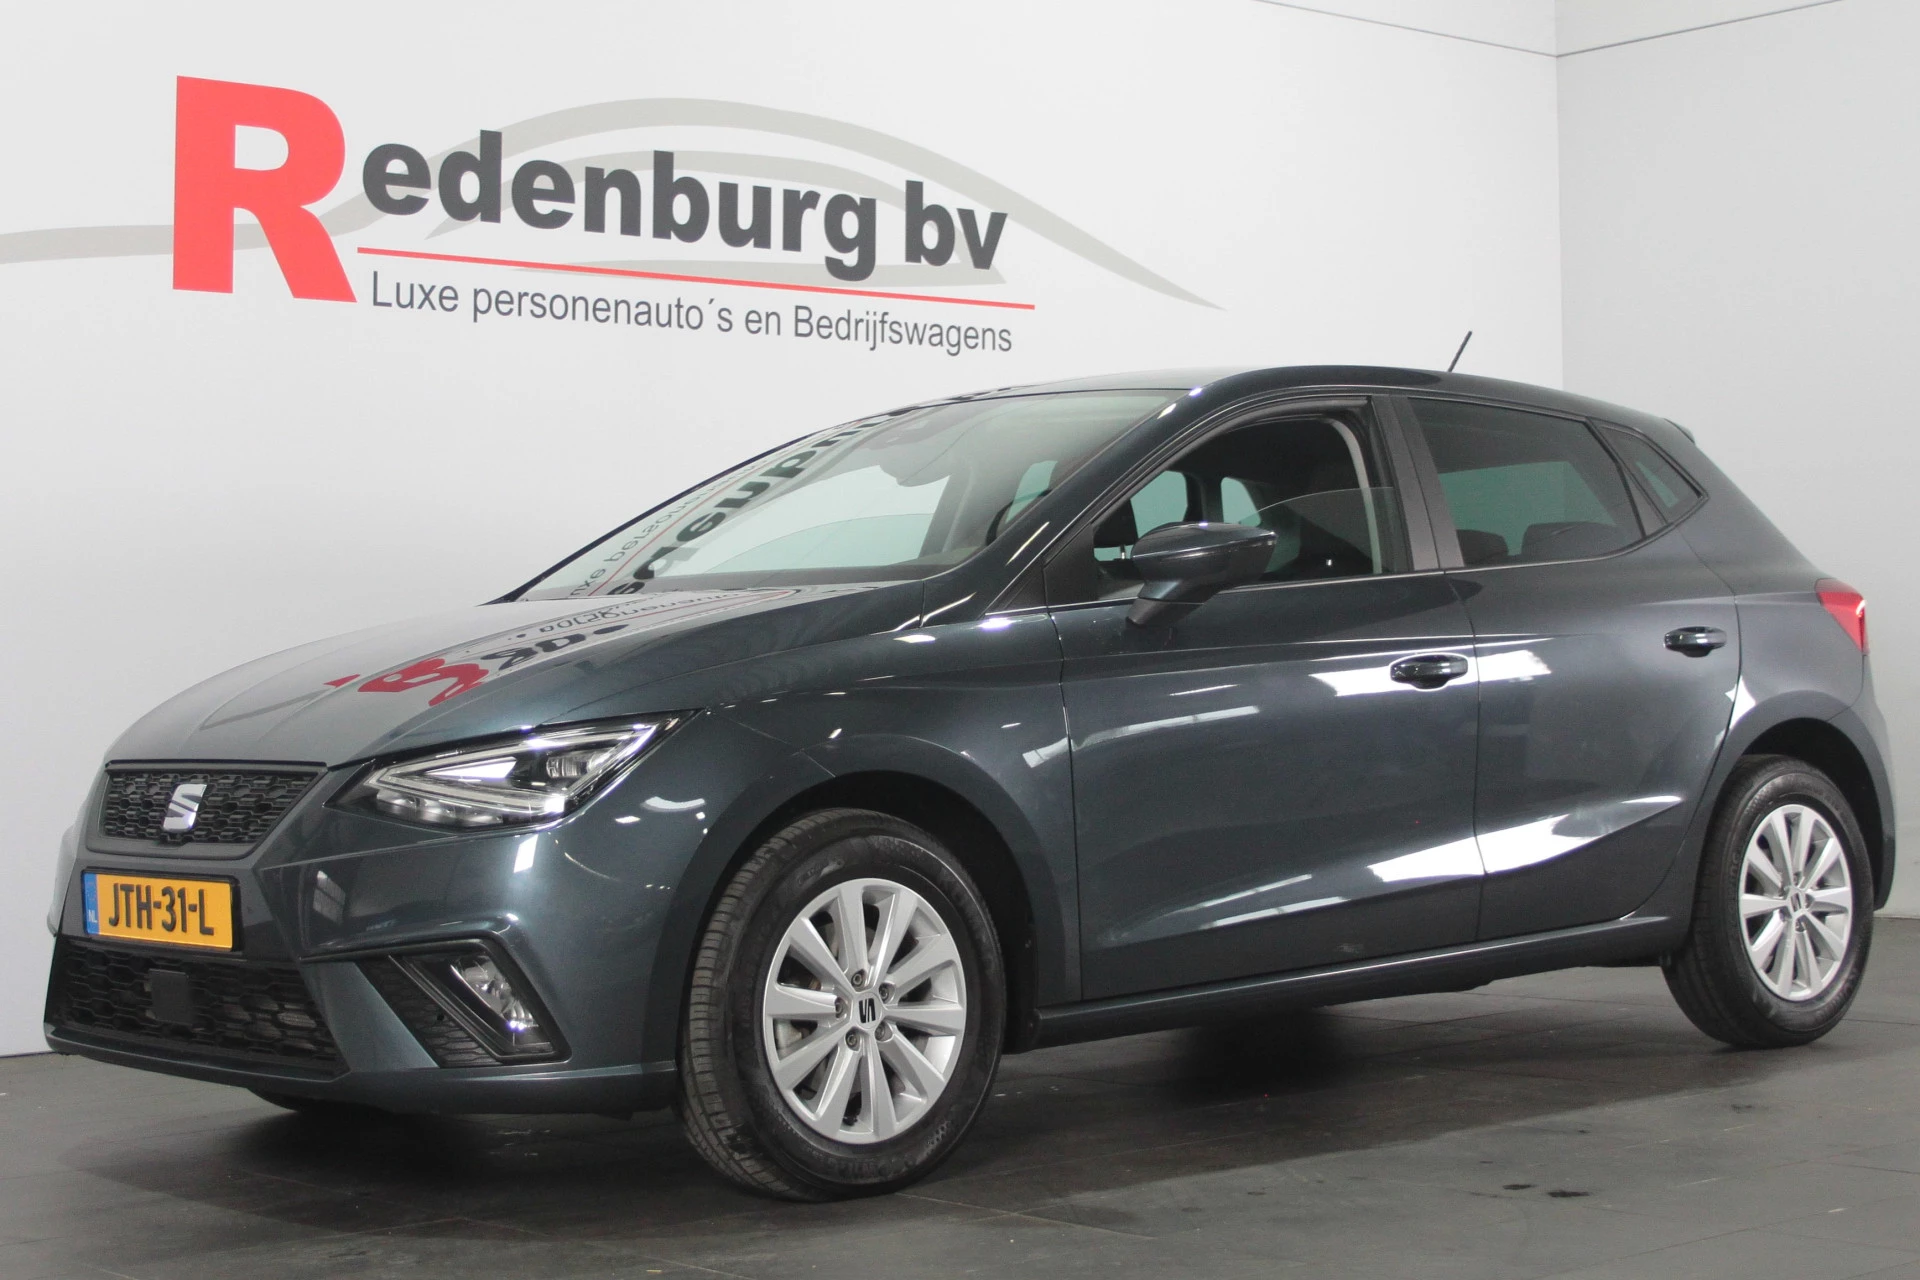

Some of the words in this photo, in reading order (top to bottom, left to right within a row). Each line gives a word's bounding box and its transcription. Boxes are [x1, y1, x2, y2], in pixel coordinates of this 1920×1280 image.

[173, 75, 877, 303] Redenburg
[905, 180, 1008, 270] bv
[373, 270, 459, 312] Luxe
[745, 310, 781, 335] en
[794, 305, 1012, 357] Bedrijfswagens
[88, 909, 98, 923] NL
[108, 882, 215, 936] JTH-31-L
